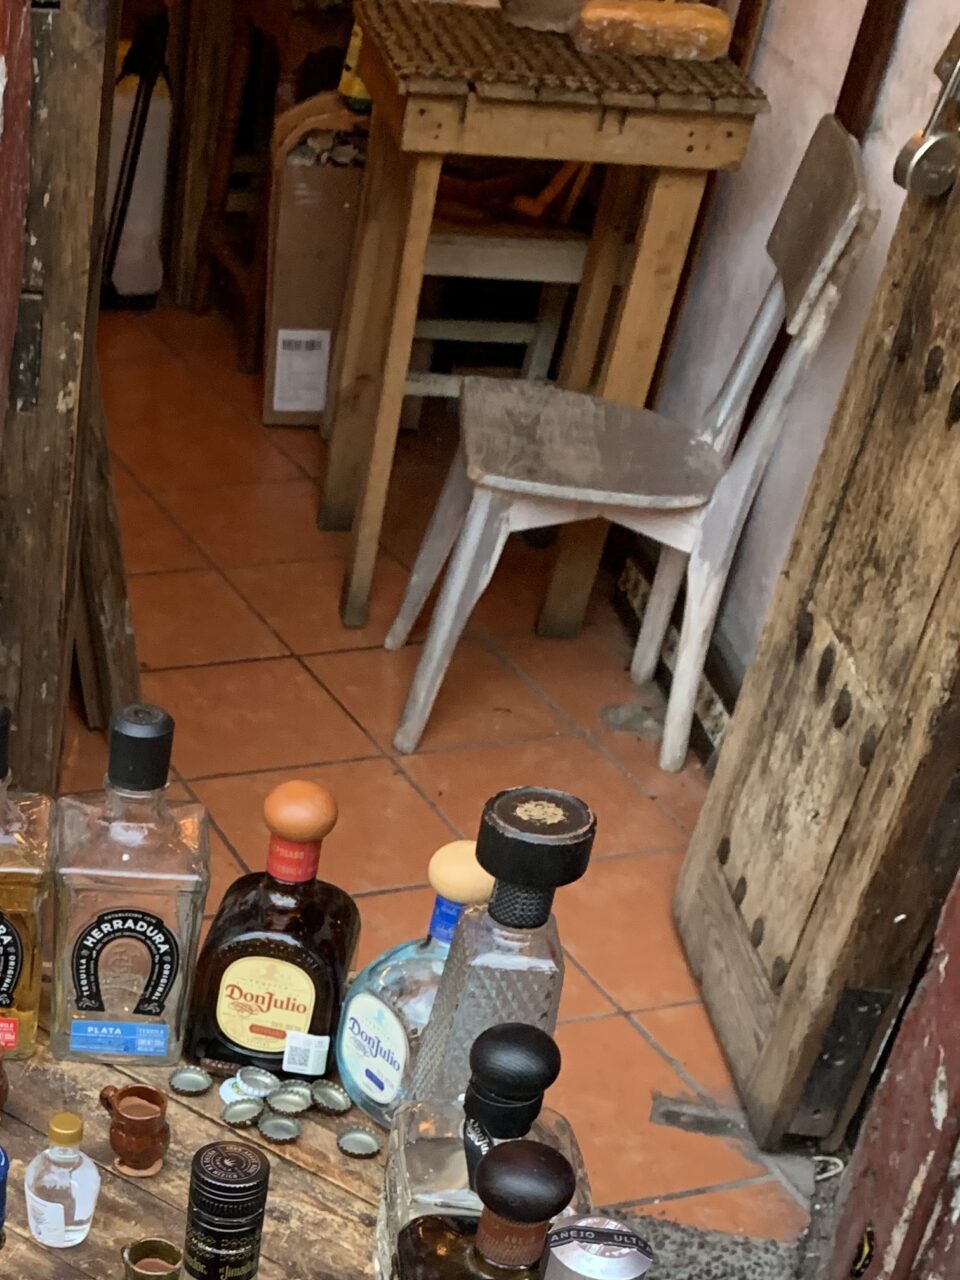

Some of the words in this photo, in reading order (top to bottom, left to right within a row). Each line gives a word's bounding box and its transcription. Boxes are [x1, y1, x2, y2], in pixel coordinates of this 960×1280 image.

[83, 919, 169, 954] HERRADURA
[0, 954, 16, 992] ORIGINAL
[79, 958, 90, 996] TEQUILA
[151, 964, 171, 1000] ORIGINAL
[87, 1026, 122, 1035] PLATA
